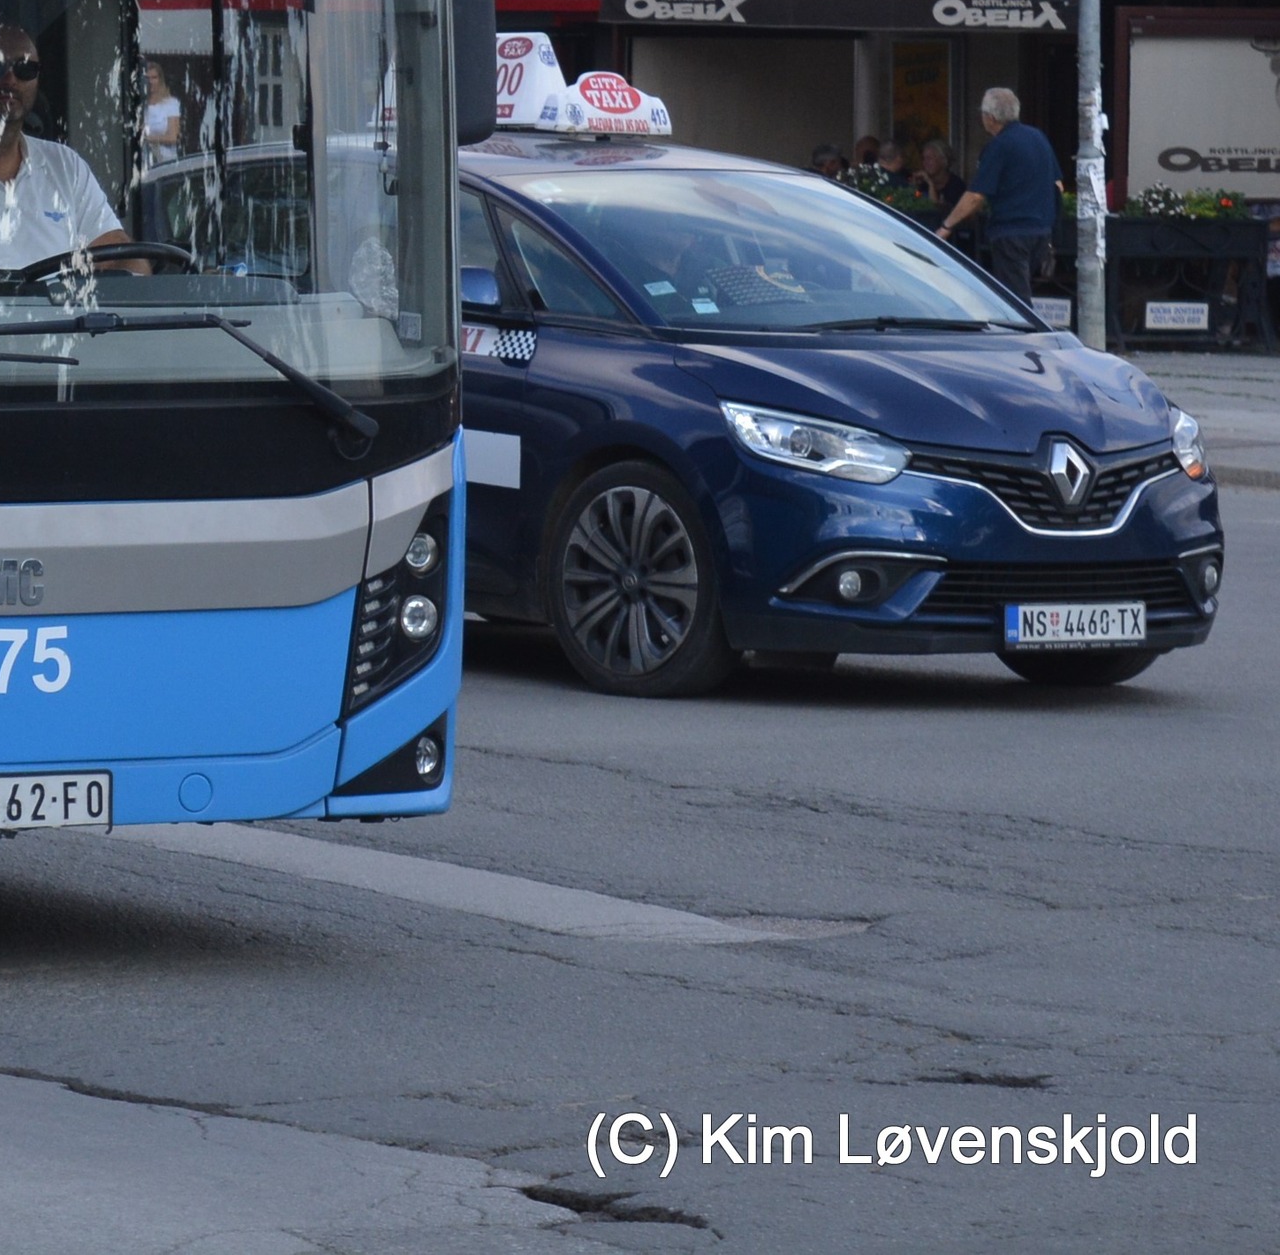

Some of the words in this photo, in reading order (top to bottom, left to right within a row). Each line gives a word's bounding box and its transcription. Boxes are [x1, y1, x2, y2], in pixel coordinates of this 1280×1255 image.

[590, 78, 617, 90] CITY
[585, 90, 635, 110] TAXI
[650, 108, 669, 126] 413
[1023, 610, 1047, 637] NS
